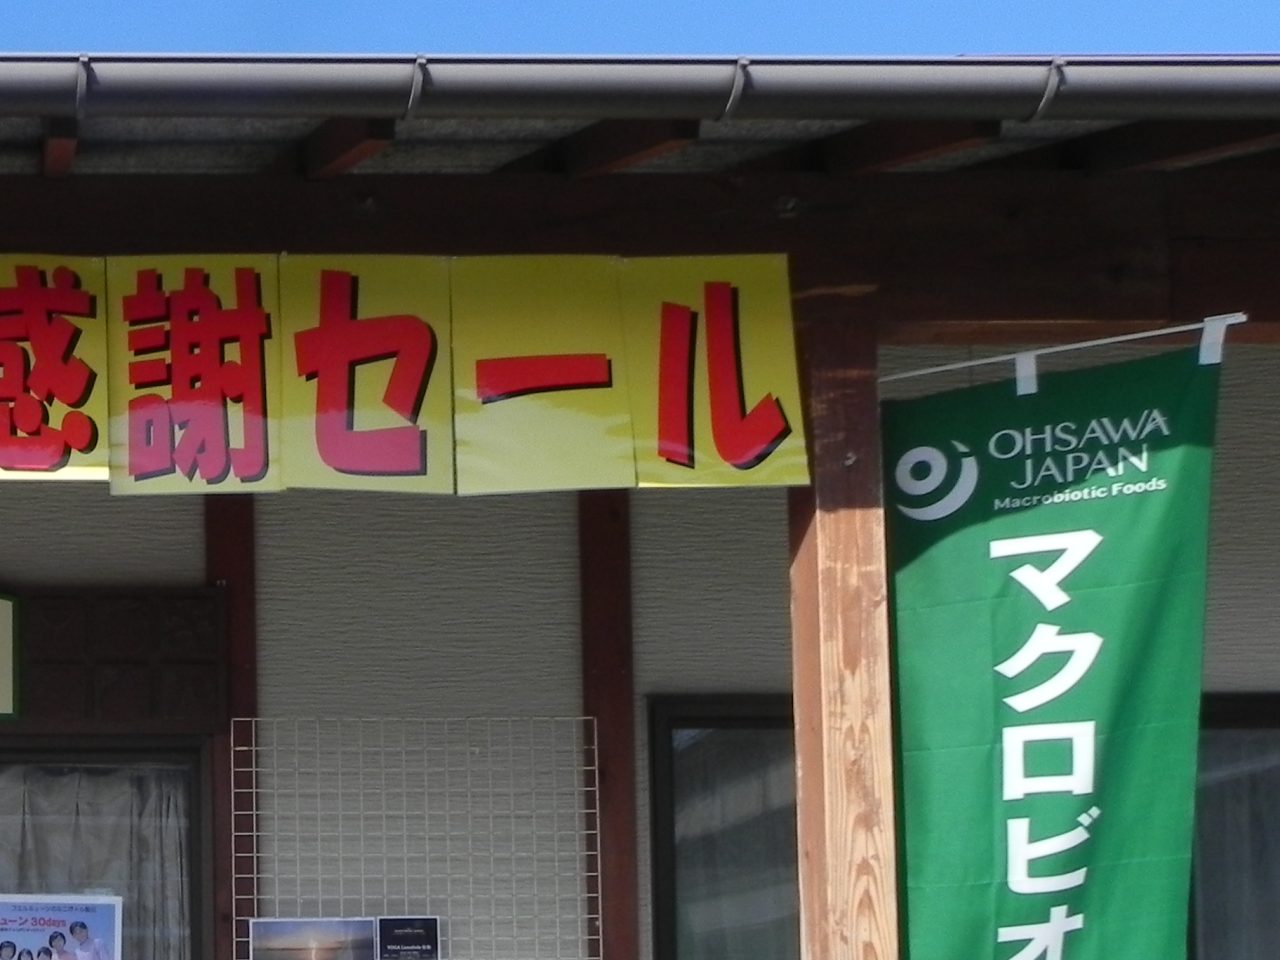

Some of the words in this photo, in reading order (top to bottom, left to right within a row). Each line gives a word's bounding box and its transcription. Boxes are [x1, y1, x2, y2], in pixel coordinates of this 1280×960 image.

[989, 408, 1171, 459] OHSAWA
[1010, 444, 1148, 489] JAPAN
[994, 485, 1108, 510] Macrobiotic
[1112, 476, 1167, 496] Foods
[31, 916, 67, 927] 30days
